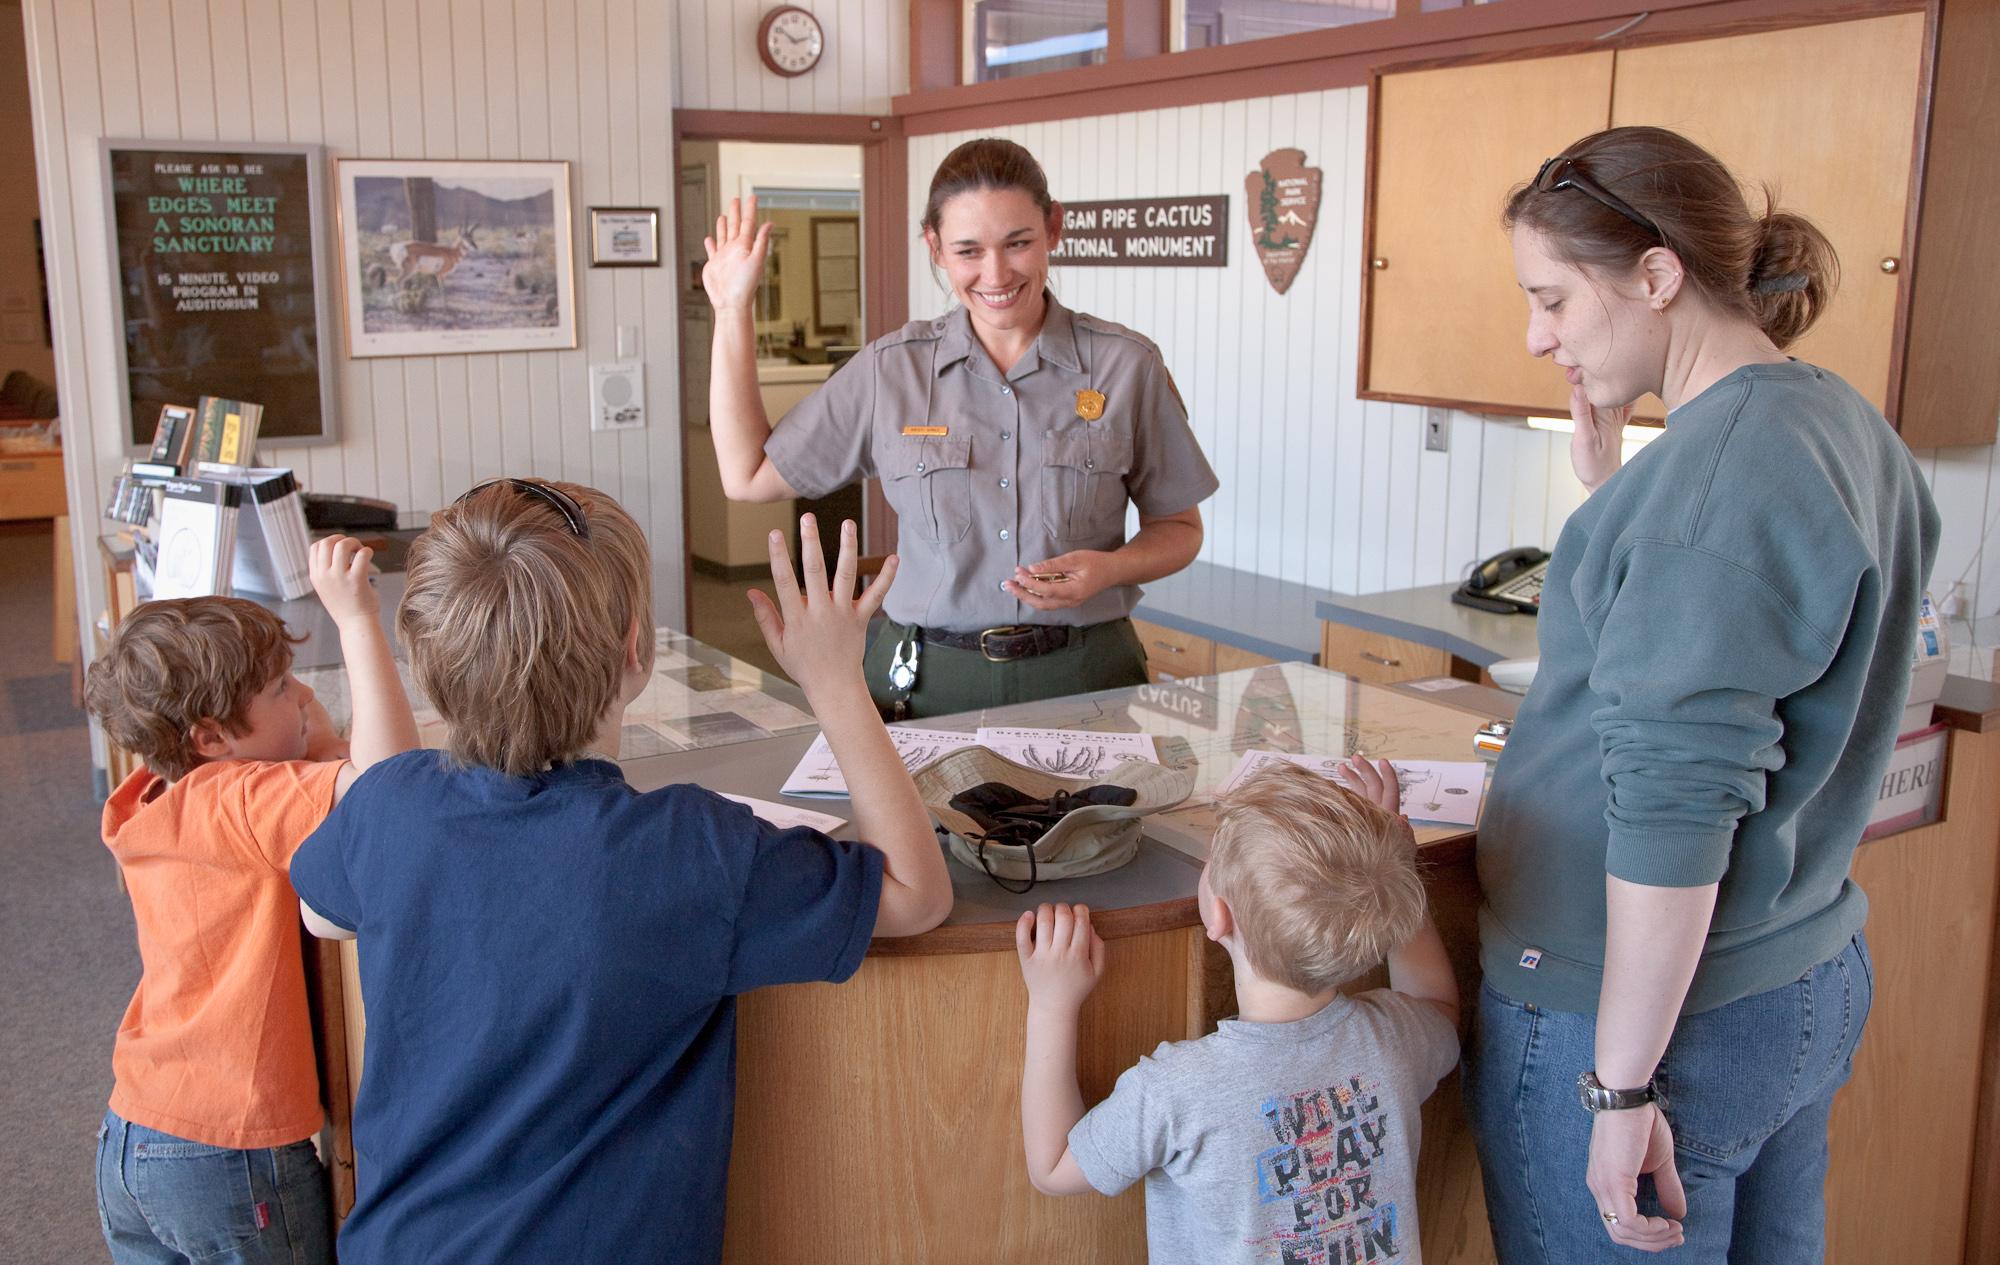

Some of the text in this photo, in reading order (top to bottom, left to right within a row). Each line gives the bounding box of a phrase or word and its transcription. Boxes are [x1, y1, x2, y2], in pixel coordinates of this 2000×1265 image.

[154, 164, 264, 175] PLEASE ASK TO SEE
[178, 178, 247, 194] WHERE
[148, 197, 277, 213] EDGES MEET
[155, 217, 274, 233] A SONORAN
[1063, 204, 1213, 230] GAN PIPE CACTUS
[153, 237, 275, 252] SANCTUARY
[1050, 235, 1216, 258] ATIONAL MONUMENT
[158, 272, 280, 286] 15 MINUTE VIDEO
[173, 285, 258, 298] PROGRAM IN
[176, 298, 258, 311] AUDITORIUM
[1879, 758, 1938, 800] HERE
[1268, 1113, 1387, 1196] PLAY
[1292, 1175, 1377, 1232] FOR
